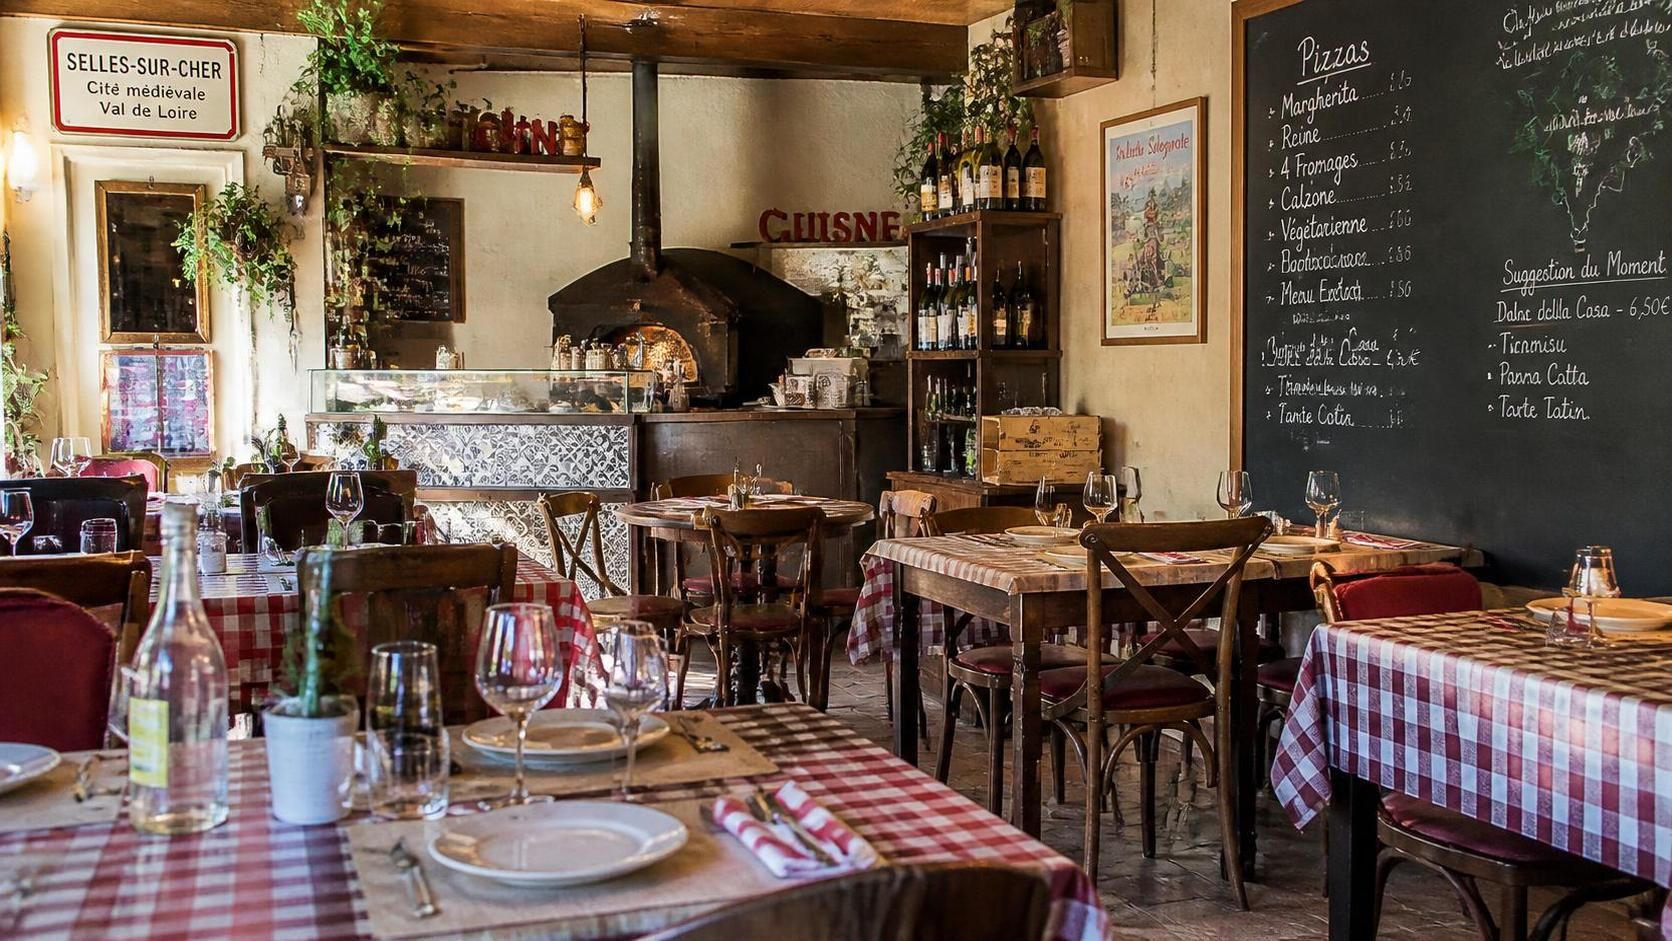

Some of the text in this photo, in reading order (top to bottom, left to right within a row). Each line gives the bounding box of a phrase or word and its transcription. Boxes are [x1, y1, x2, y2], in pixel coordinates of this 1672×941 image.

[67, 52, 222, 79] SELLES-SUR-CHER
[1297, 36, 1371, 78] Pizzas
[87, 80, 206, 101] Cité médiévale
[1281, 80, 1359, 125] Margherita
[99, 101, 198, 120] Val de Loire
[1280, 156, 1290, 180] 4
[1295, 152, 1359, 185] Fromages
[1281, 184, 1337, 211] Calzone
[1281, 214, 1368, 252] Végétarienne
[1502, 250, 1667, 297] Suggestion du Moment
[1498, 394, 1538, 419] Tarte
